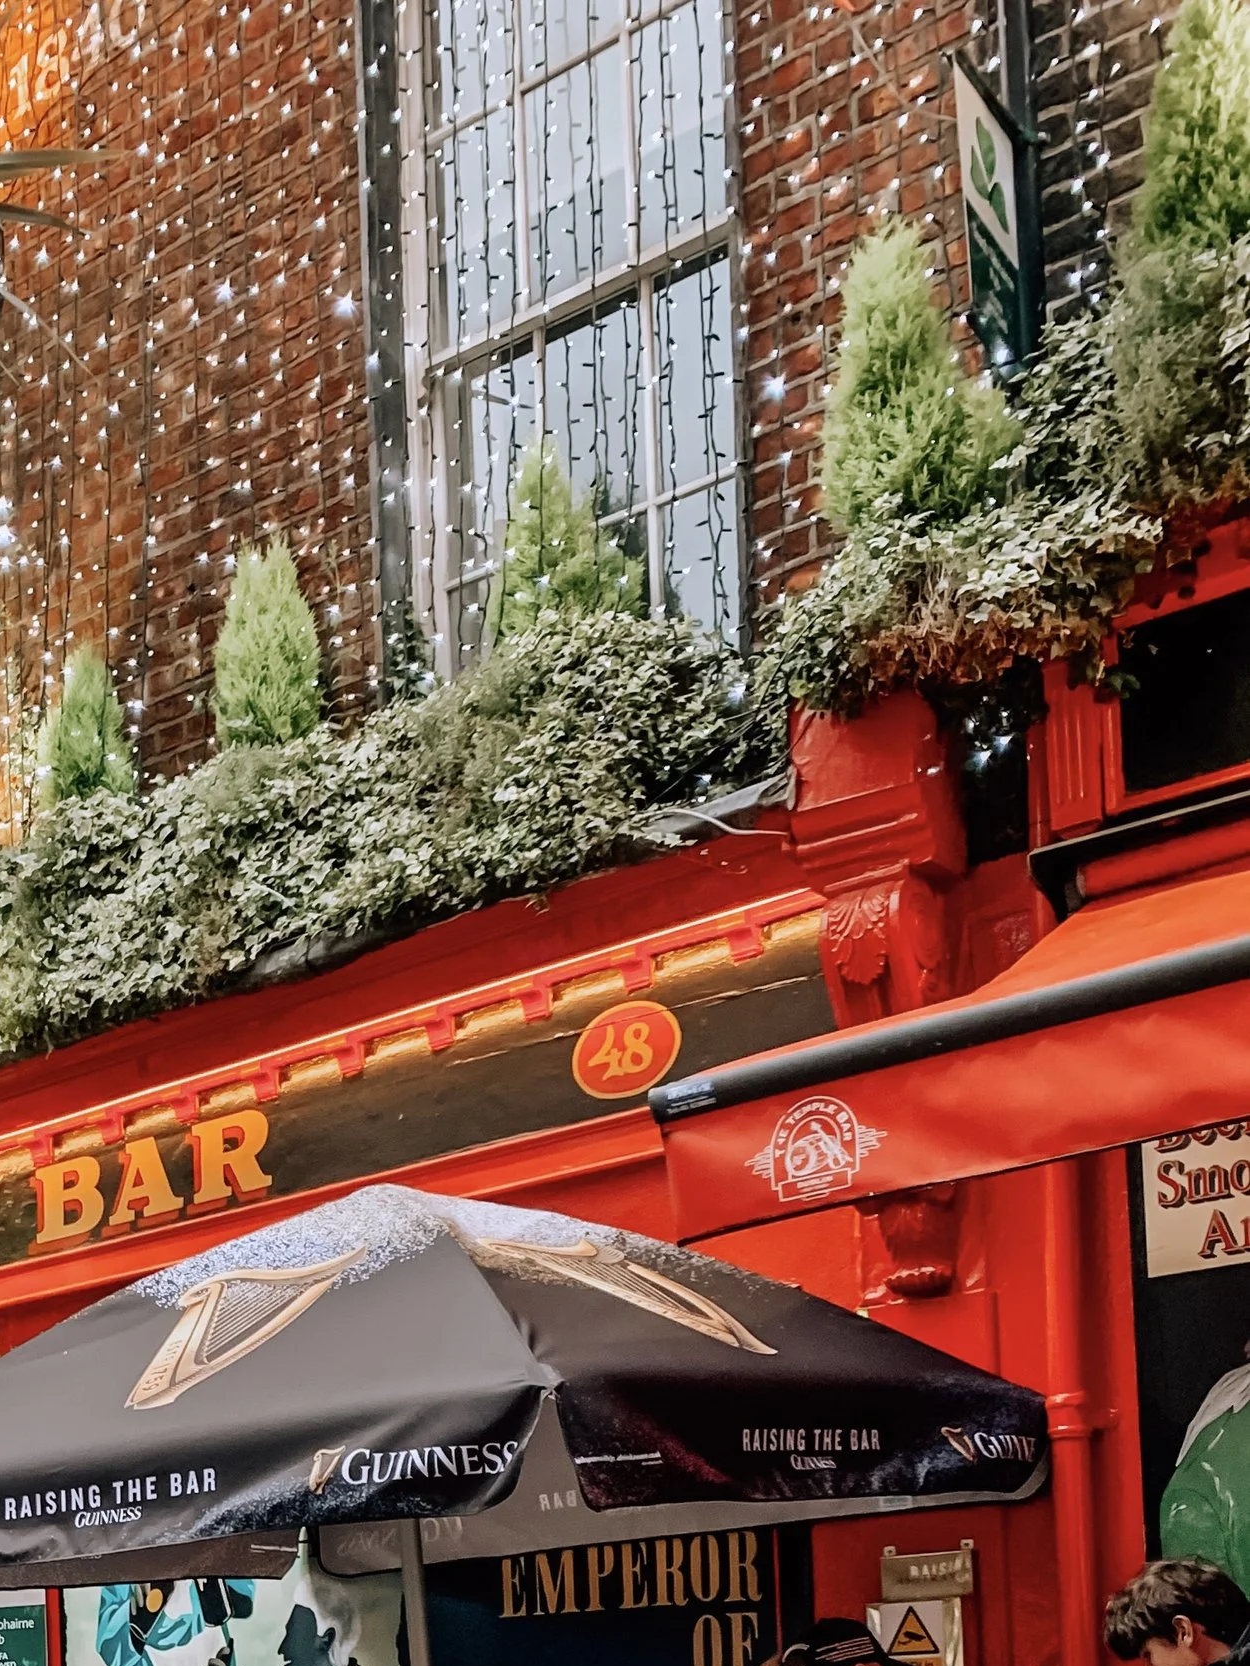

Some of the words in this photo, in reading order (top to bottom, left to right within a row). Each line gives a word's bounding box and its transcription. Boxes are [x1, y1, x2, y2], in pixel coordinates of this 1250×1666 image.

[588, 1022, 653, 1081] 48
[786, 1102, 838, 1125] TEMPLE
[836, 1111, 853, 1141] BAR
[31, 1108, 273, 1250] BAR
[341, 1441, 519, 1486] GUINNESS
[742, 1429, 806, 1451] RAISING
[813, 1429, 842, 1450] THE
[850, 1429, 881, 1450] BAR
[4, 1484, 101, 1520] RAISING
[112, 1475, 158, 1505] THE
[169, 1467, 217, 1497] BAR
[74, 1506, 142, 1529] GUINNESS
[498, 1531, 763, 1619] EMPEROR
